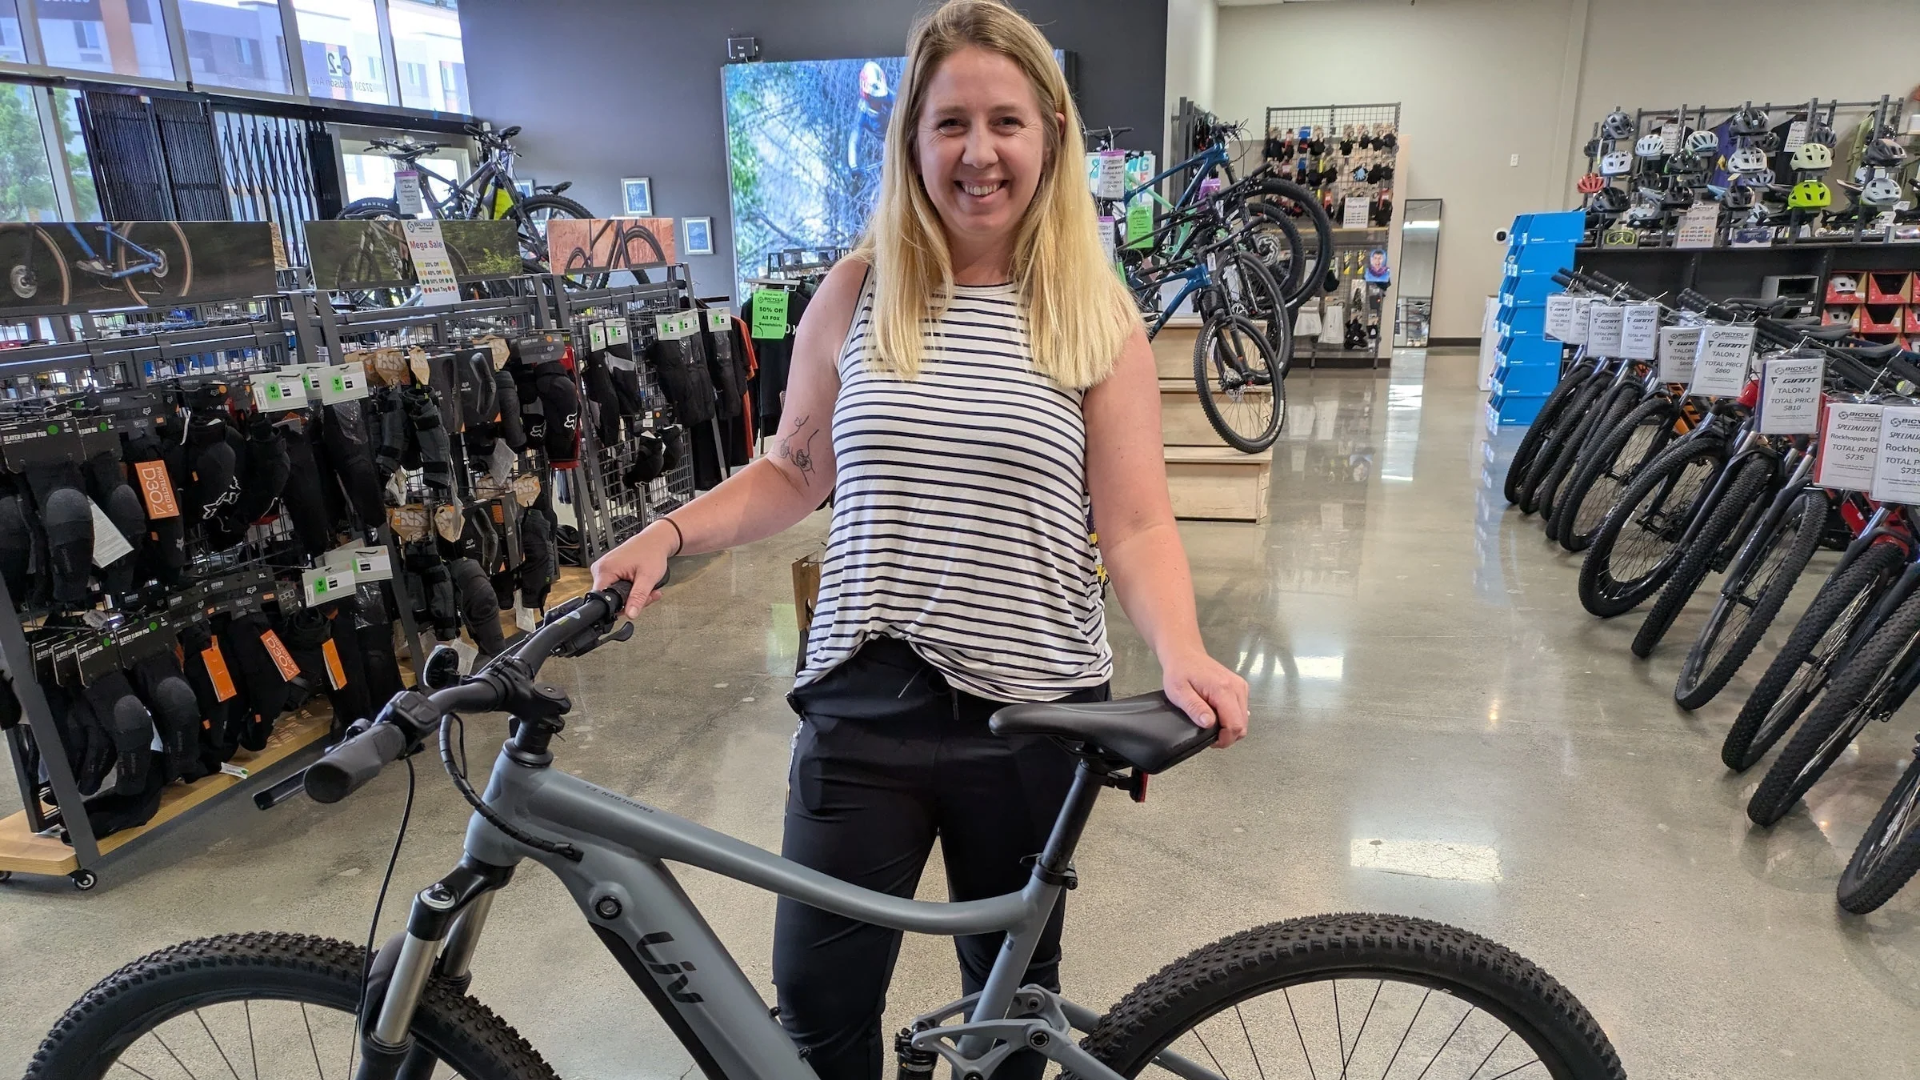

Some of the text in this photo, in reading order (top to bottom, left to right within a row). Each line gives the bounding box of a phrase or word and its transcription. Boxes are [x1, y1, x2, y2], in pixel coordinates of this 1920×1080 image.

[409, 240, 443, 251] Mega Sale
[1836, 423, 1876, 432] SPECIALIZED
[1831, 433, 1868, 442] Rockhopper
[1886, 457, 1912, 465] TOTAL
[1901, 467, 1920, 475] $735
[142, 468, 163, 504] D3O
[156, 466, 172, 503] PROTECTED
[601, 791, 654, 813] EMBOLDEN
[636, 931, 705, 1003] Liv
